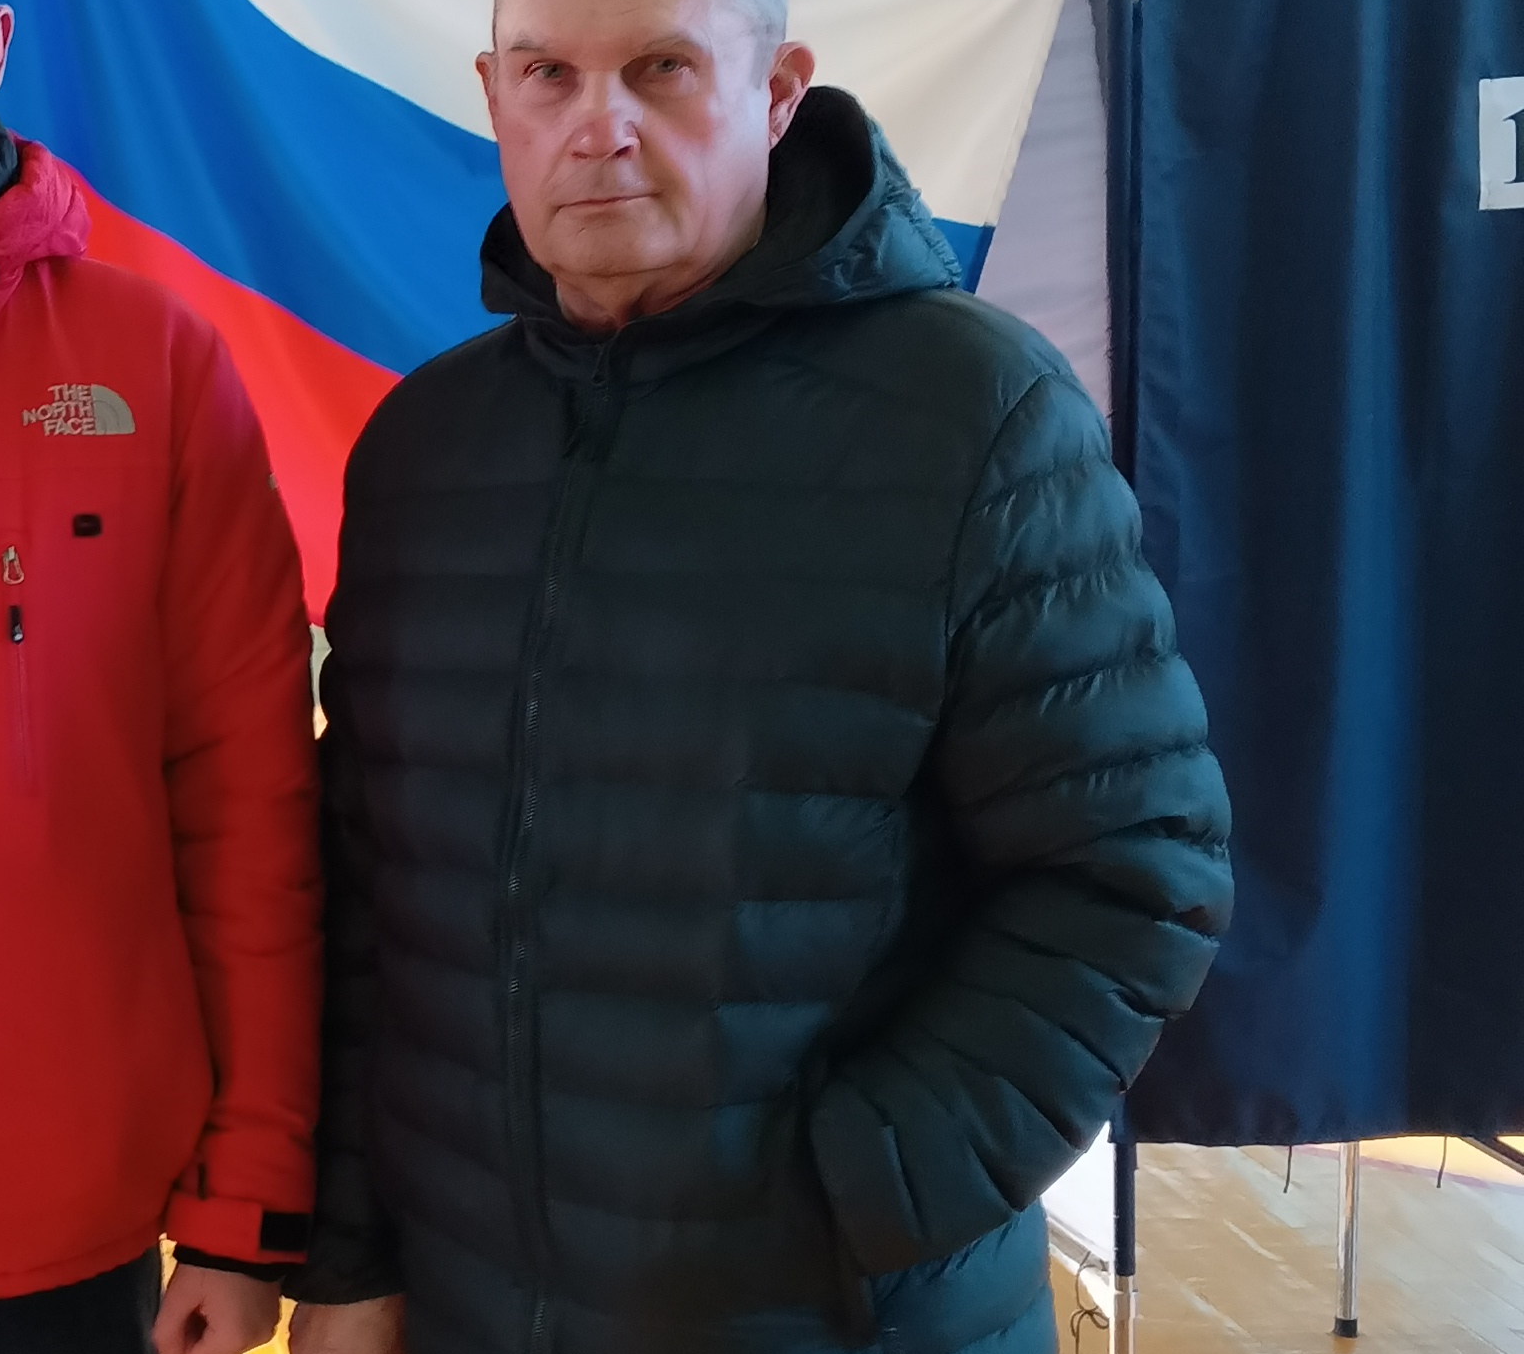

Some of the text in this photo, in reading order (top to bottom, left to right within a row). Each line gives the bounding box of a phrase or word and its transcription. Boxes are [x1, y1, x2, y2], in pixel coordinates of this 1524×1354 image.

[47, 383, 92, 402] THE
[21, 400, 94, 427] NORTH
[43, 417, 97, 437] FACE
